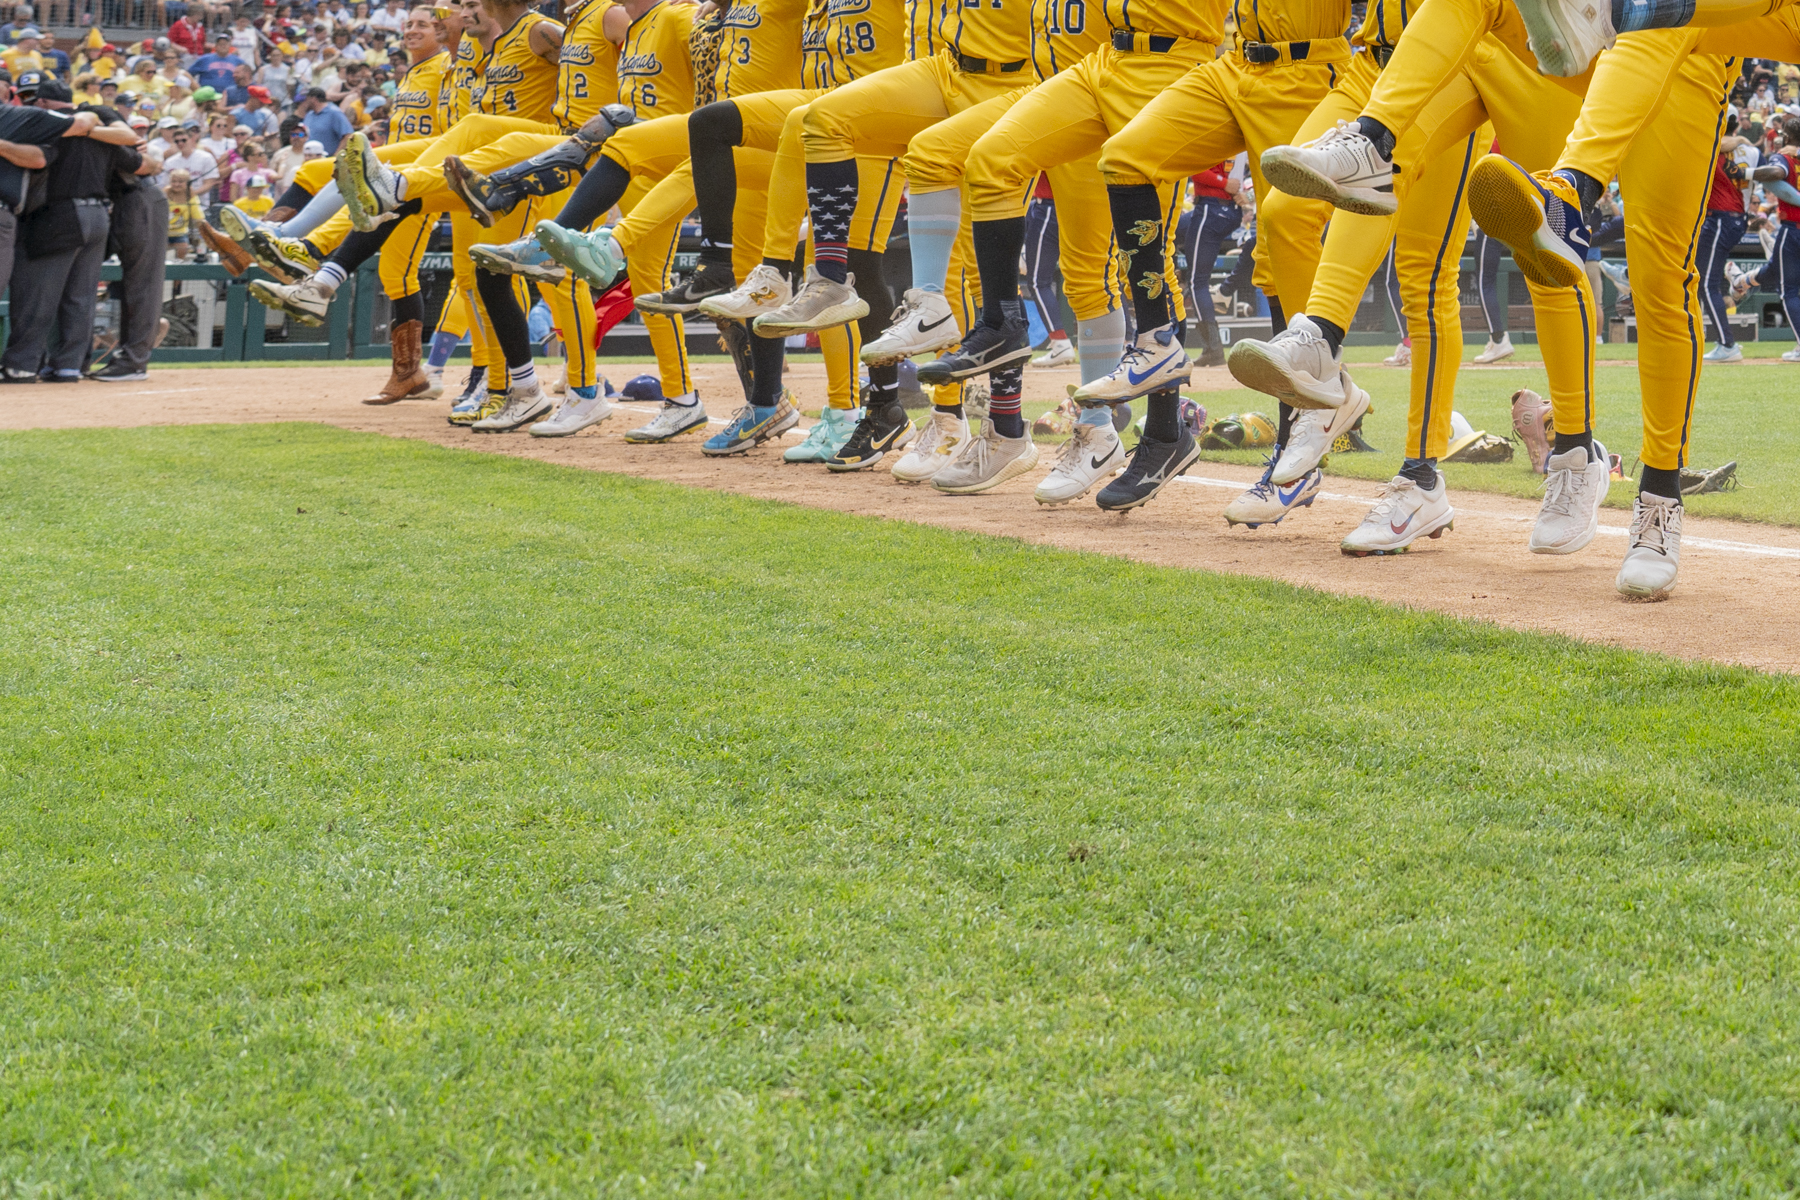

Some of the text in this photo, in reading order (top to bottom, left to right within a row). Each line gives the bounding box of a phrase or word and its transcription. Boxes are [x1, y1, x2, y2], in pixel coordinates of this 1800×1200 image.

[737, 36, 750, 65] 3
[844, 21, 876, 56] 18
[574, 72, 588, 99] 2
[641, 83, 657, 107] 6
[503, 89, 517, 112] 4
[403, 114, 433, 136] 66
